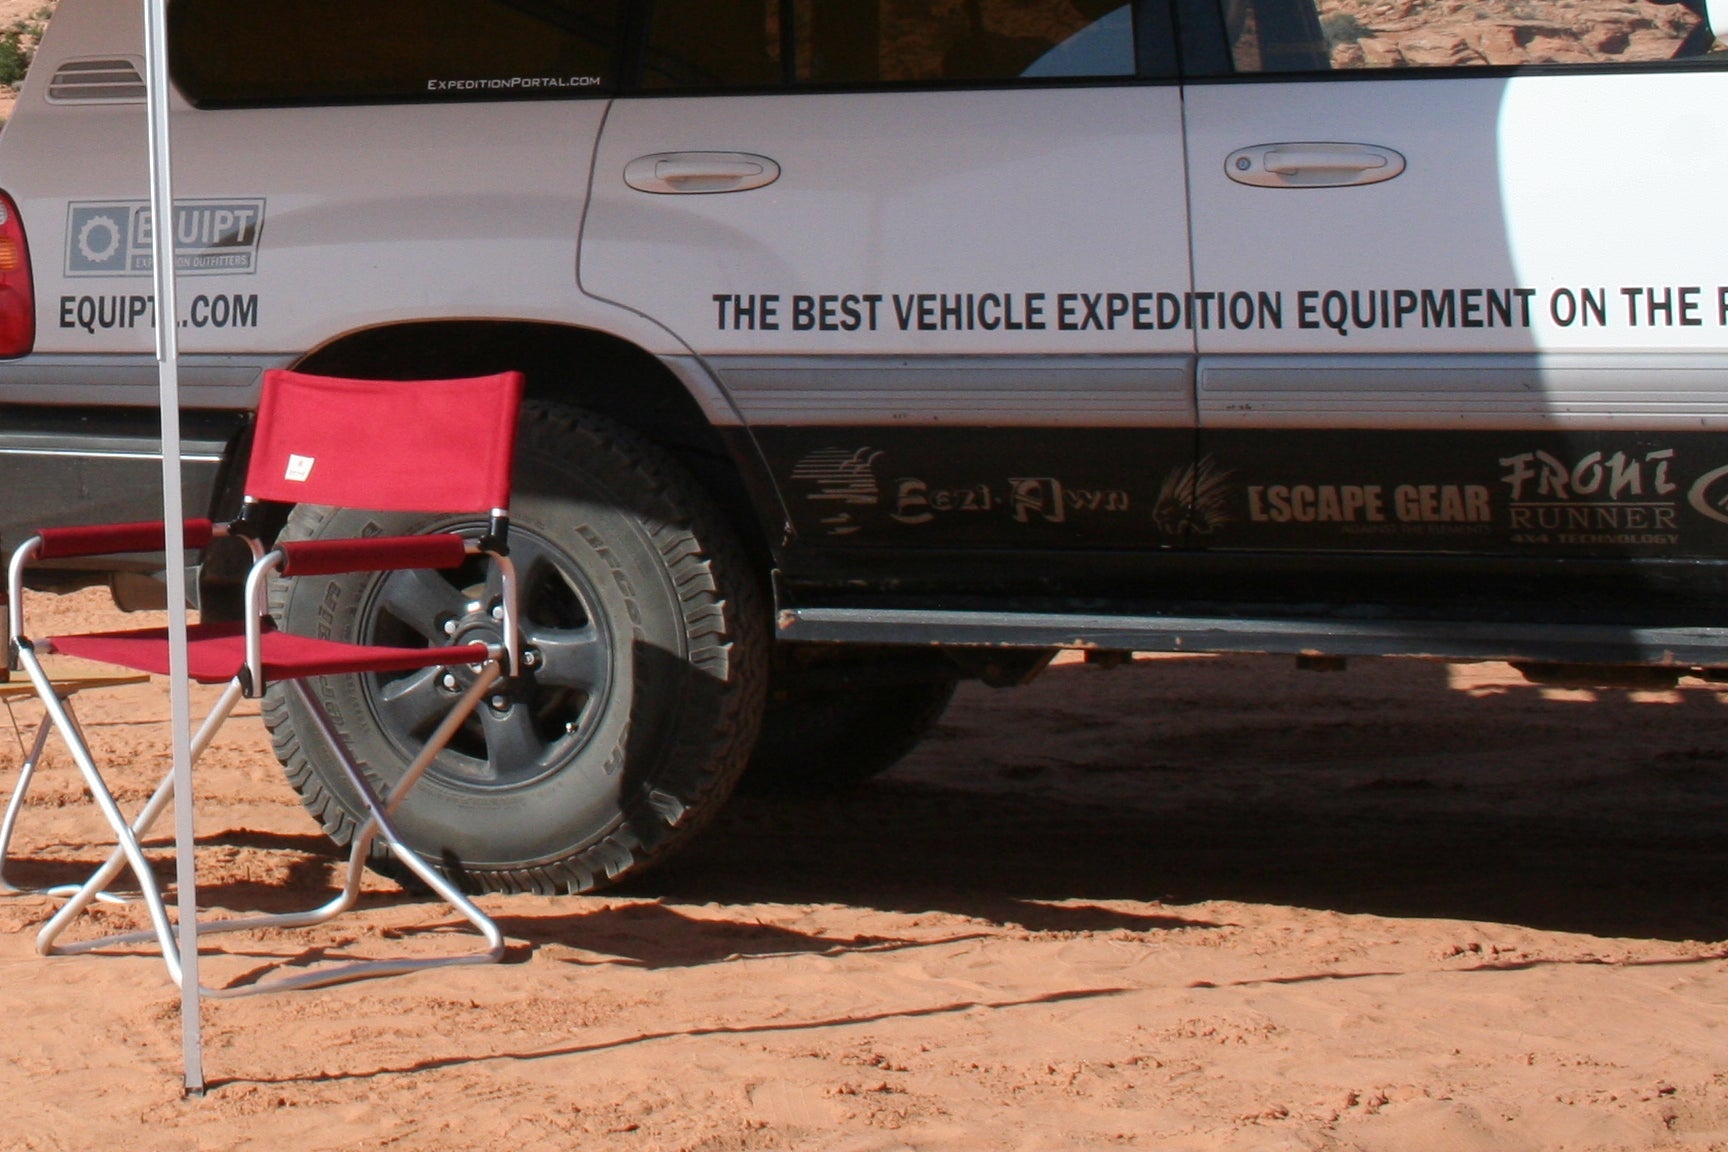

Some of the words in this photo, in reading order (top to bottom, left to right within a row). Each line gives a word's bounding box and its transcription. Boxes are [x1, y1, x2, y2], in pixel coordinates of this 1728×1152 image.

[139, 210, 253, 244] EUIPT
[192, 254, 248, 267] OUTFITTERS
[59, 294, 258, 334] EQUIPT.COM
[713, 293, 779, 330] THE
[792, 293, 882, 331] BEST
[892, 292, 1046, 330] VEHICLE
[1057, 290, 1282, 331] EXPEDITION
[1297, 288, 1536, 336] EQUIPMENT
[1549, 287, 1606, 327] ON
[1620, 287, 1702, 326] THE
[1498, 448, 1678, 500] FRONT
[1248, 484, 1385, 522] ESCAPE
[1394, 483, 1491, 522] GEAR
[1509, 507, 1678, 529] RUNNER
[1556, 533, 1679, 545] TECHNOLOGY
